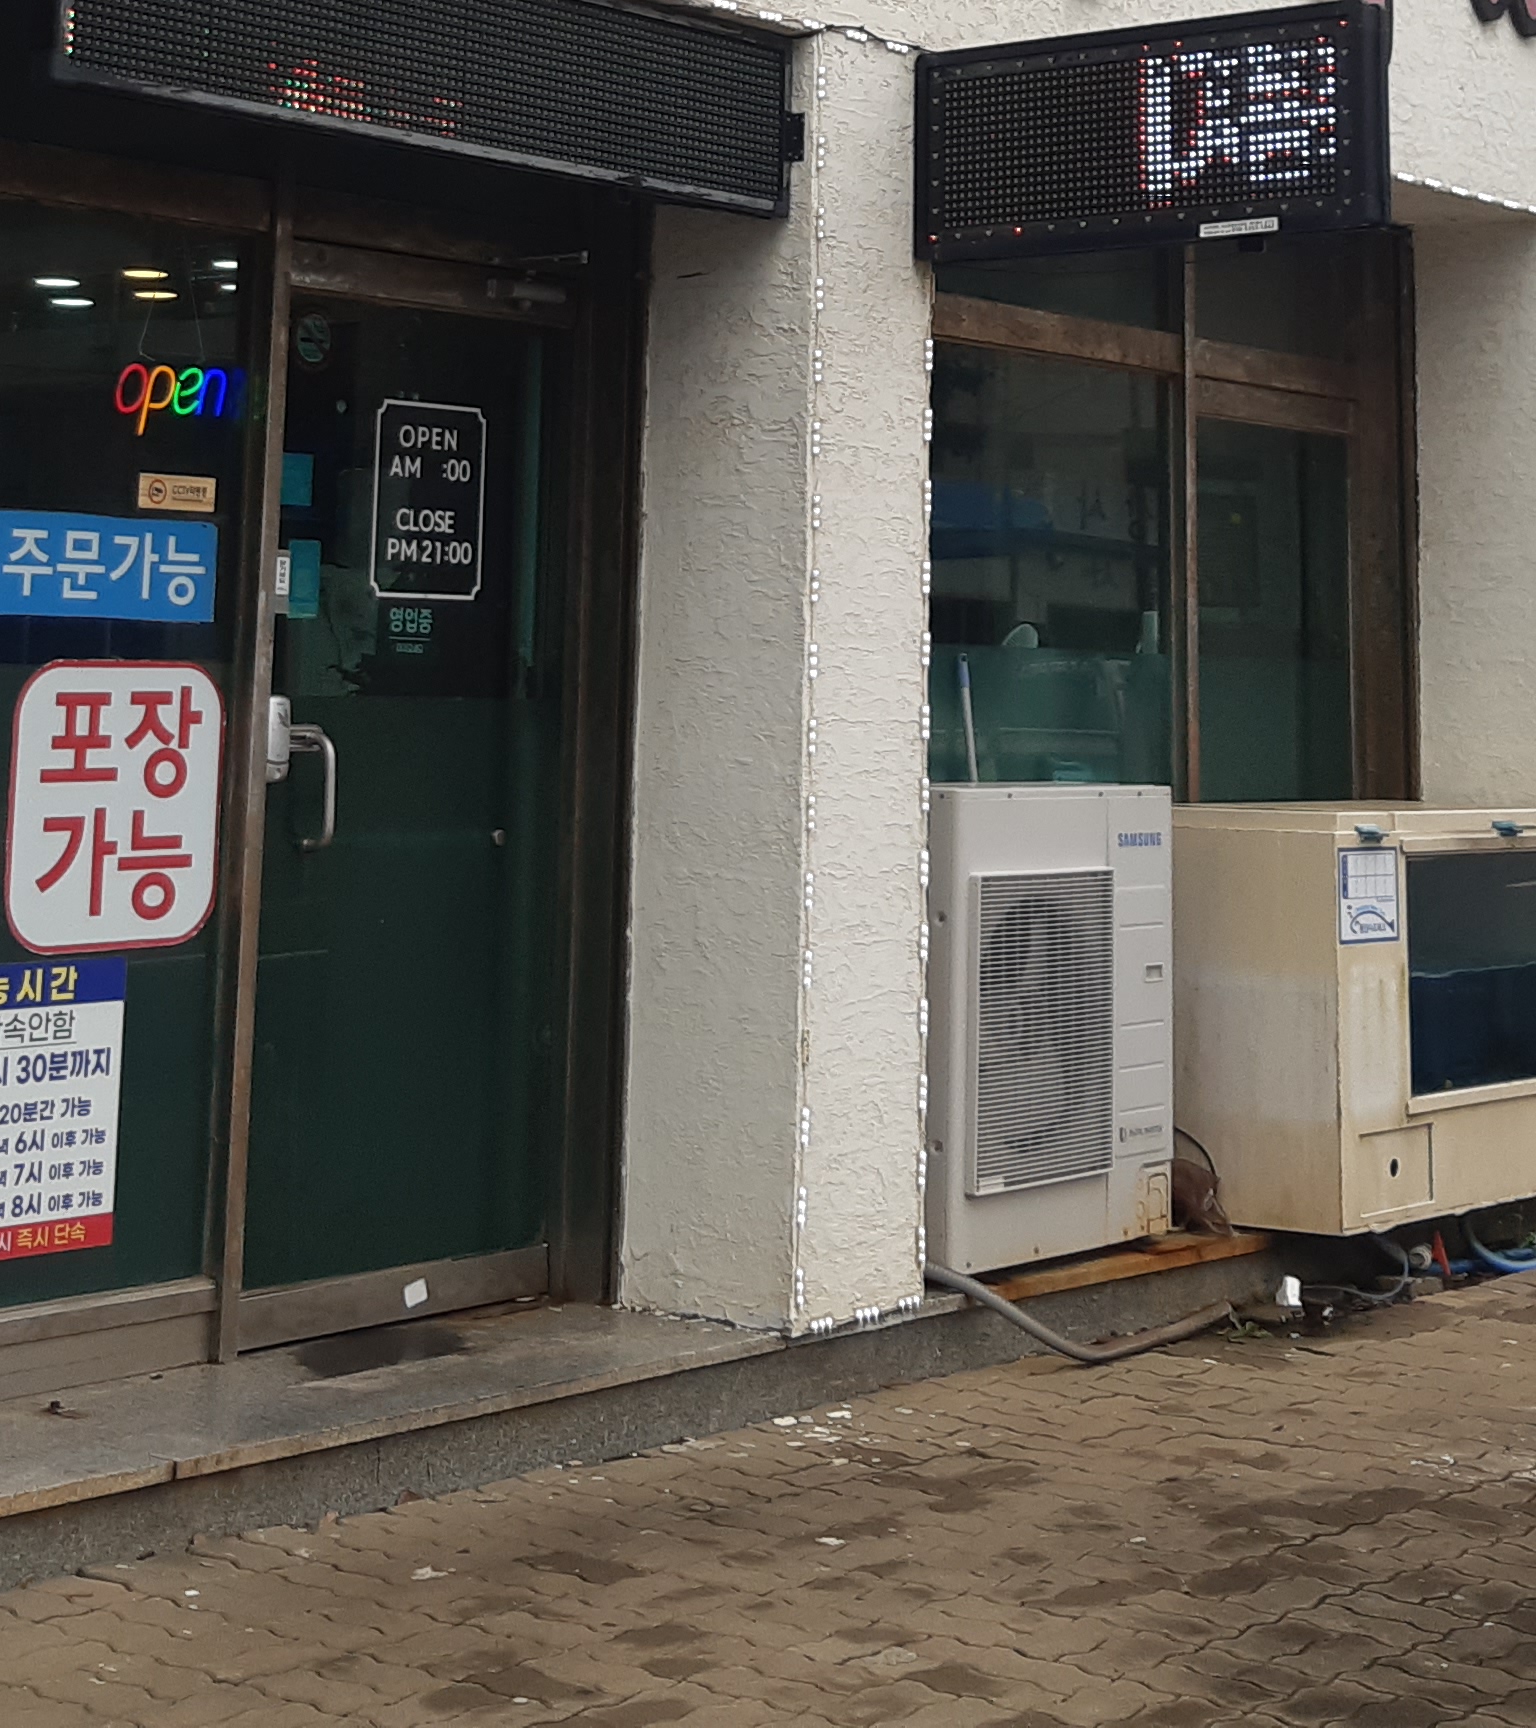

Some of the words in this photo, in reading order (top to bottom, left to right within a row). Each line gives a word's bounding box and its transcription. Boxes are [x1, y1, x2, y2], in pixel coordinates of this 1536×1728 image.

[115, 362, 228, 437] open
[399, 424, 458, 452] OPEN
[389, 454, 422, 479] AM
[395, 507, 456, 534] CLOSE
[385, 537, 418, 563] PM
[421, 539, 473, 566] 21:00
[2, 527, 207, 607] 주문가능
[389, 606, 433, 635] 영업중
[38, 684, 202, 801] 포장
[1117, 831, 1162, 847] SAMSUNG
[34, 807, 194, 922] 가능
[15, 1046, 112, 1085] 30분까지
[60, 1096, 92, 1119] 가능
[14, 1128, 46, 1154] 6시
[51, 1130, 77, 1149] 이후
[80, 1127, 107, 1145] 가능
[13, 1160, 43, 1187] 7시
[48, 1162, 75, 1181] 이후
[78, 1158, 104, 1177] 가능
[10, 1191, 42, 1218] 8시
[47, 1193, 74, 1212] 이후
[77, 1189, 104, 1208] 가능
[16, 1225, 49, 1250] 즉시
[54, 1221, 86, 1246] 단속
